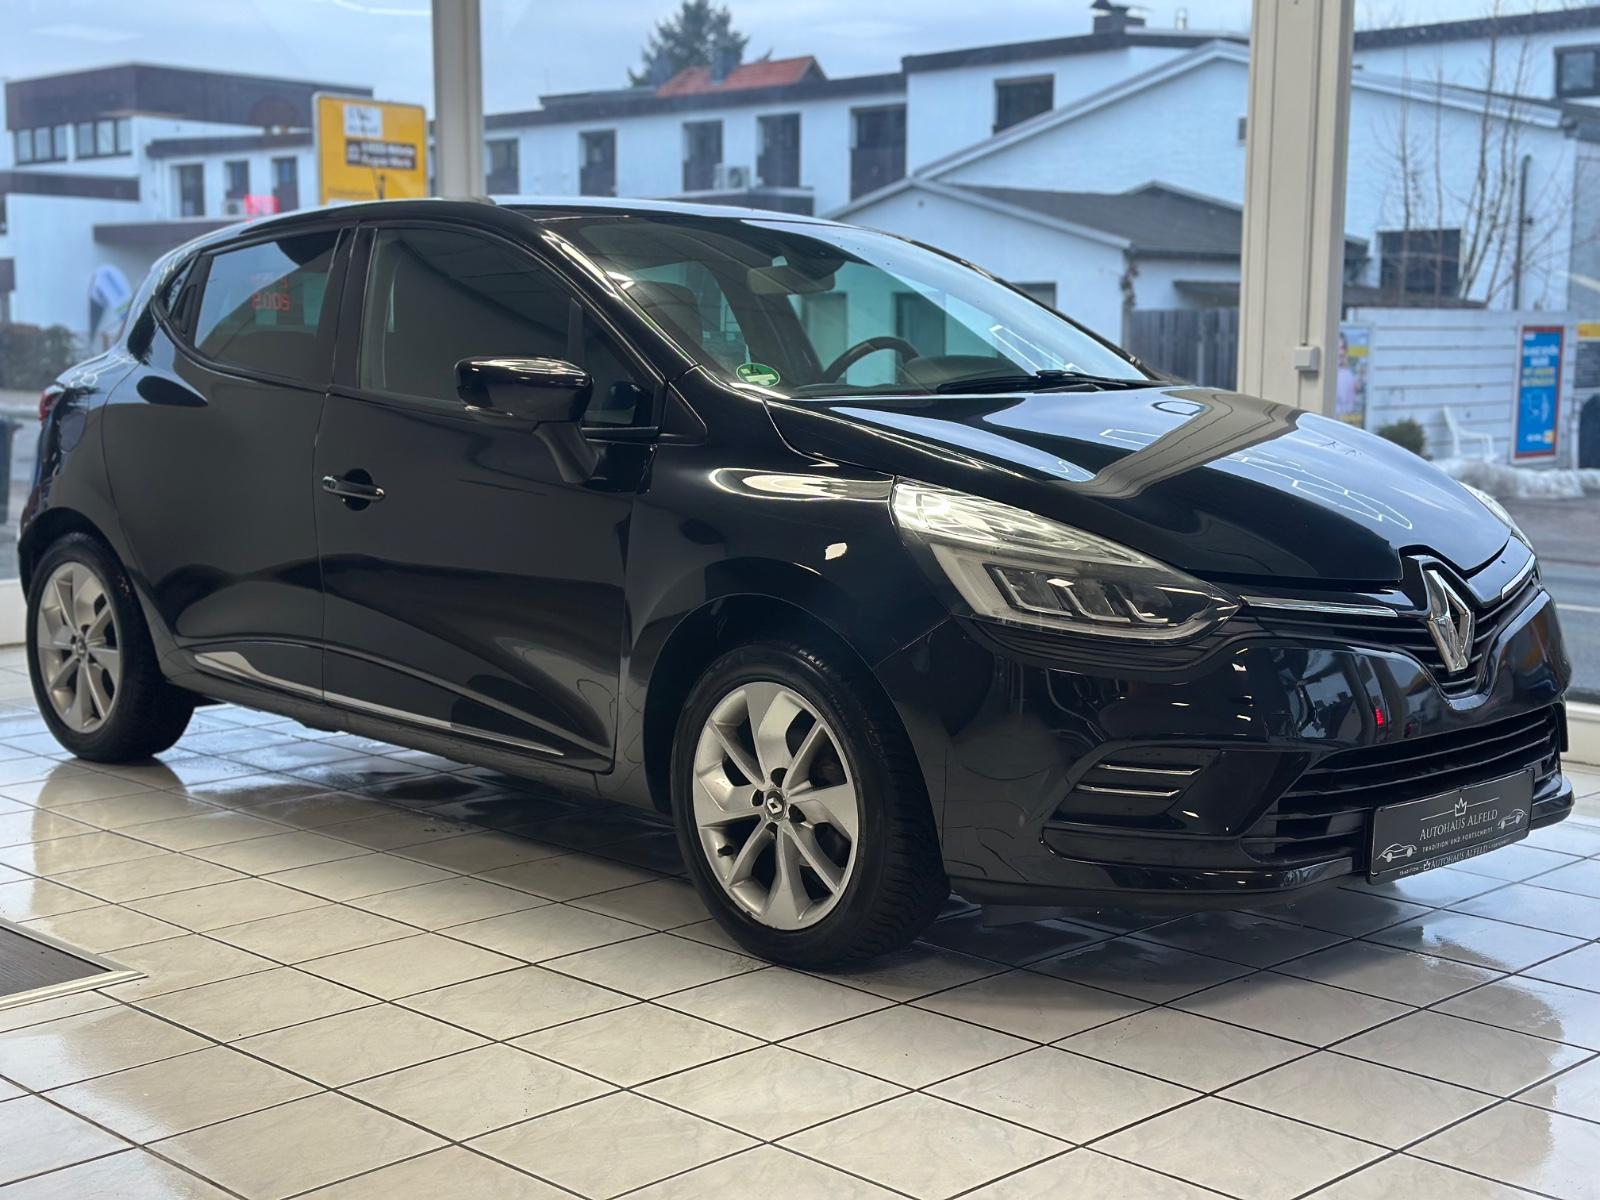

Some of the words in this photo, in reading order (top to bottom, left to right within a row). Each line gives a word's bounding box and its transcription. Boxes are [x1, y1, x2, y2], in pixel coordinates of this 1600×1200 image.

[1419, 817, 1466, 841] AUTOHAUS
[1466, 809, 1498, 827] ALFELD
[1422, 840, 1449, 853] TRADITION
[1450, 836, 1461, 845] UND
[1462, 826, 1493, 842] FORTSCHRITT
[1430, 852, 1465, 869] AUTOHAUS
[1466, 845, 1488, 859] ALFELD
